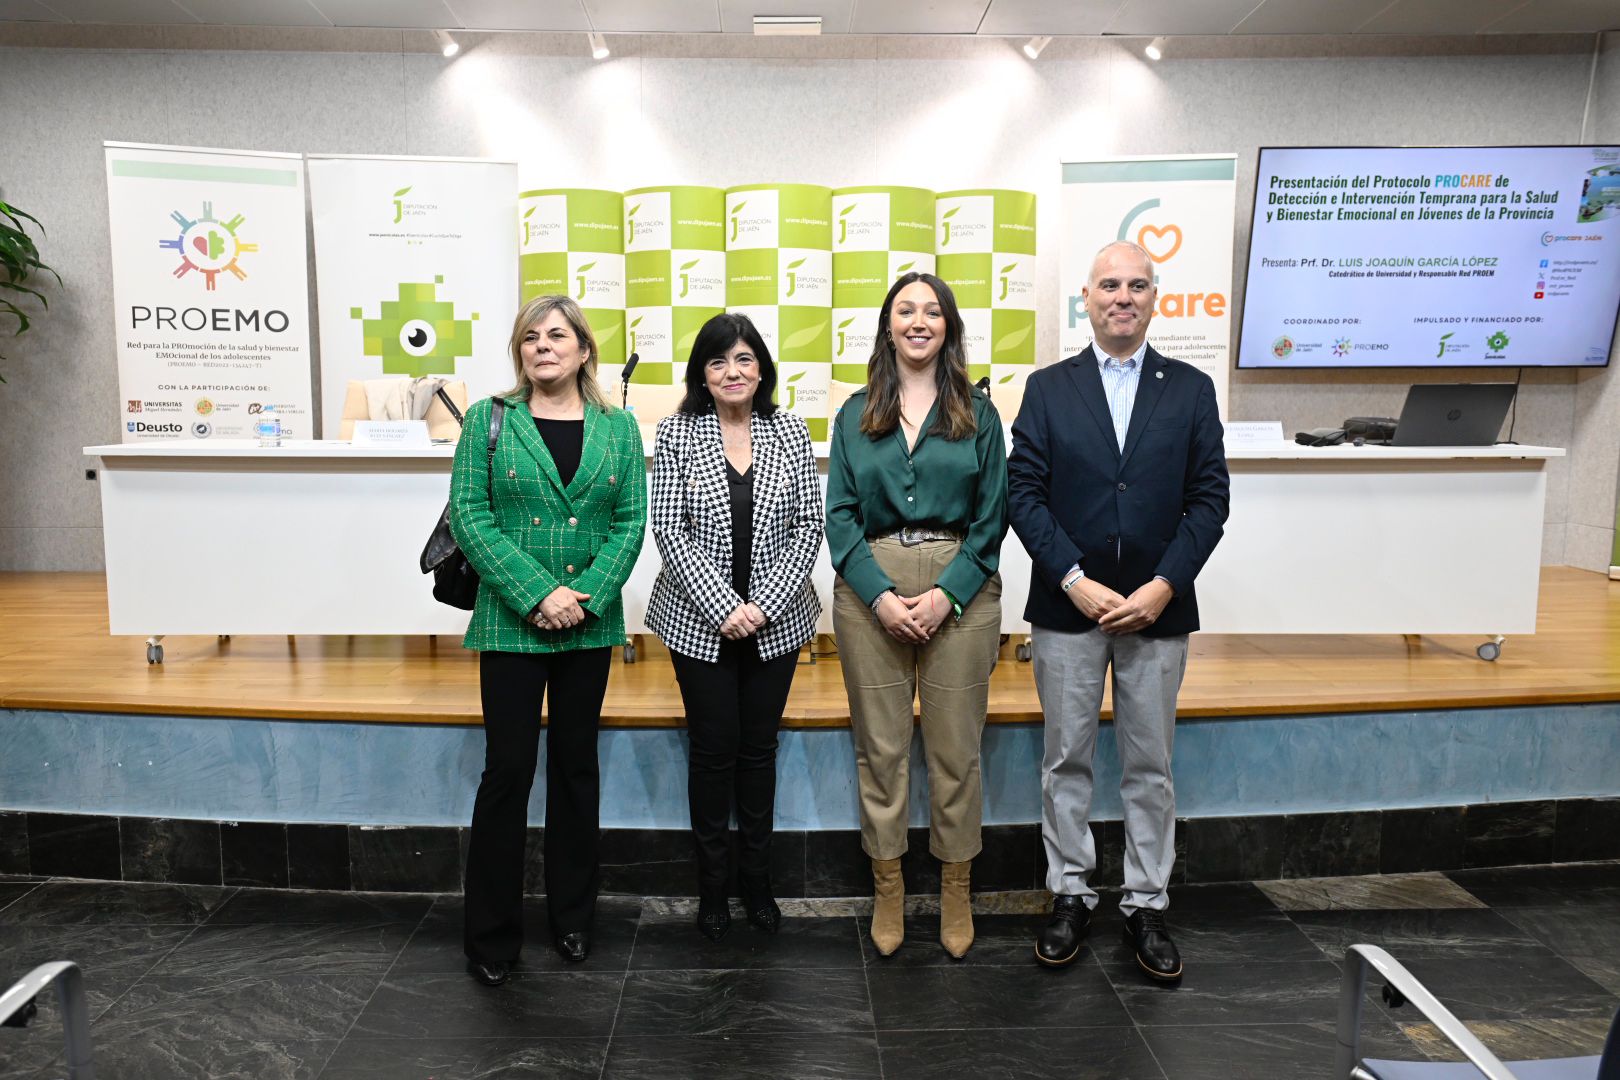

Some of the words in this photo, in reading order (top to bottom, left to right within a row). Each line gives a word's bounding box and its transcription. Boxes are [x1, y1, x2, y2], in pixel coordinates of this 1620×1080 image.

[1270, 175, 1348, 188] Presentación
[1352, 176, 1370, 188] del
[1374, 175, 1430, 188] Protocolo
[1435, 174, 1492, 188] PROCARE
[1495, 175, 1510, 187] de
[1268, 192, 1326, 204] Detección
[1331, 196, 1337, 204] e
[1342, 191, 1415, 204] Intervención
[1420, 192, 1476, 206] Temprana
[1480, 194, 1507, 206] para
[1511, 191, 1521, 203] la
[1526, 190, 1559, 203] Salud
[1266, 211, 1273, 223] y
[1277, 208, 1334, 220] Bienestar
[1338, 208, 1397, 220] Emocional
[1400, 210, 1414, 220] en
[1418, 207, 1463, 220] Jóvenes
[1467, 207, 1481, 219] de
[1484, 207, 1495, 219] la
[1500, 207, 1554, 219] Provincia
[1262, 258, 1298, 267] Presenta:
[1301, 258, 1318, 267] Prf.
[1322, 258, 1335, 267] Dr.
[1339, 258, 1363, 267] LUIS
[1366, 256, 1414, 267] JOAQUÍN
[1418, 256, 1459, 267] GARCÍA
[1462, 256, 1498, 267] LÓPEZ
[1419, 270, 1457, 278] Responsable
[131, 306, 289, 332] PROEMO
[137, 422, 183, 432] Deusto
